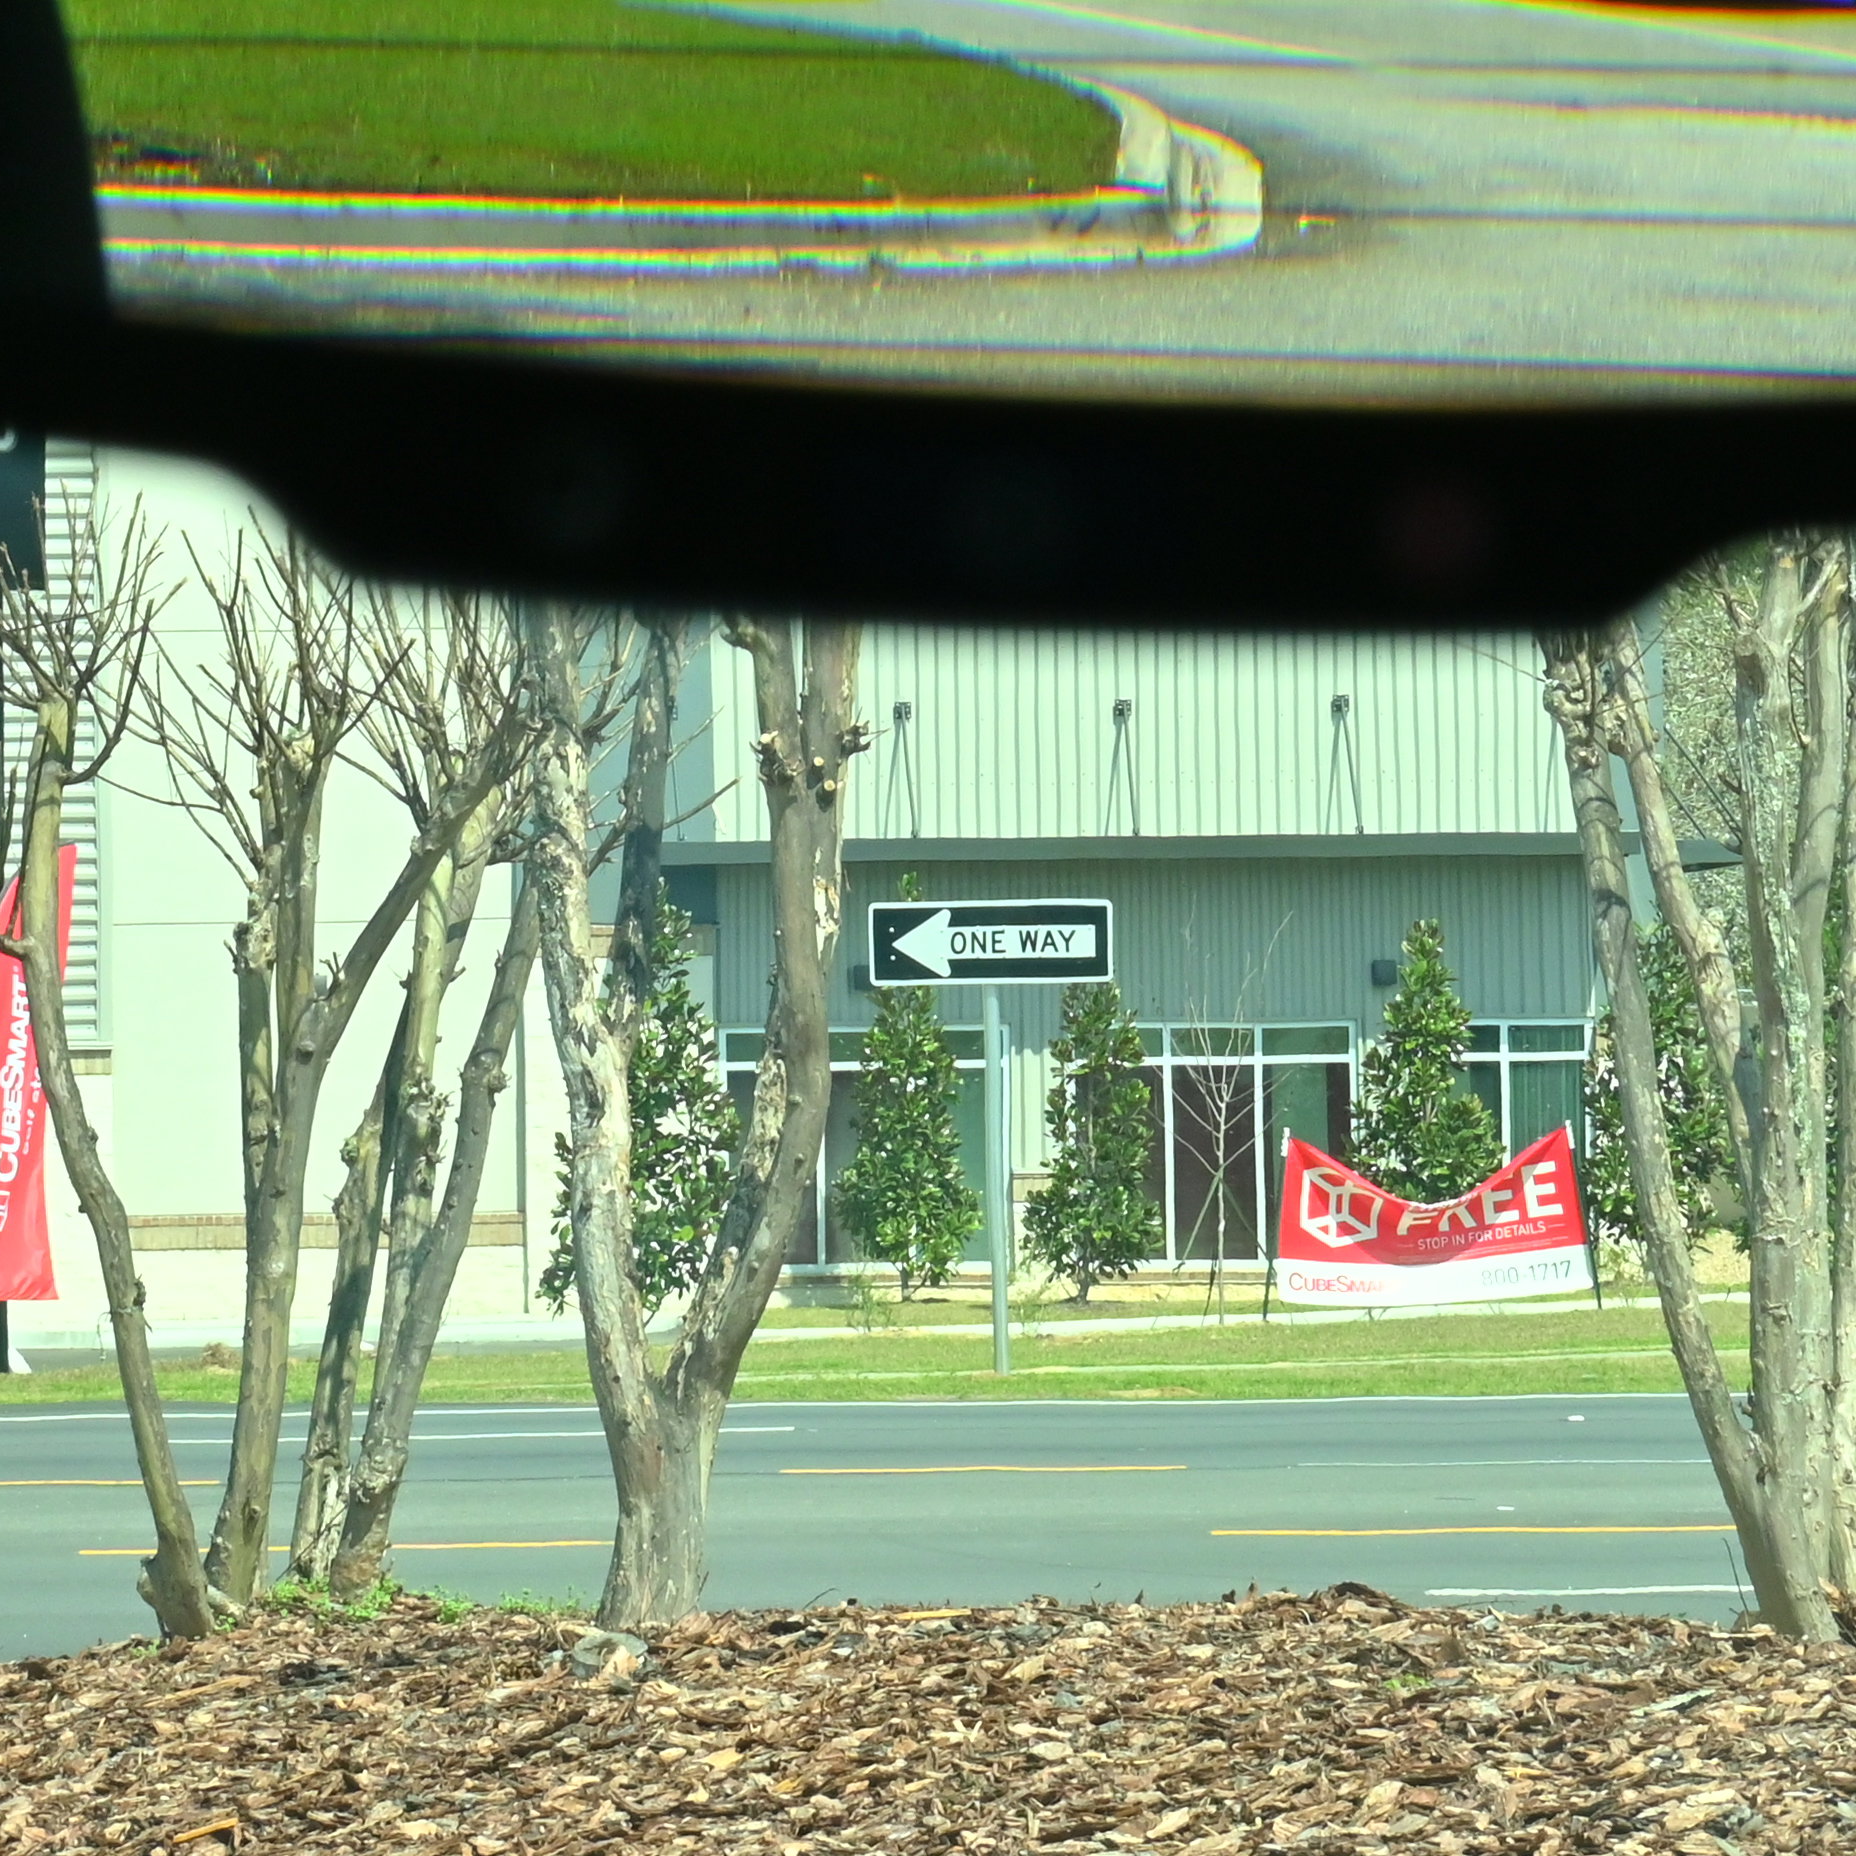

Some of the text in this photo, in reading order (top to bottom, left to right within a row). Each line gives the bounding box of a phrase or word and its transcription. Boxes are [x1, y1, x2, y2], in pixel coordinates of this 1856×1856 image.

[950, 929, 1077, 955] ONE WAY
[1417, 1221, 1547, 1251] STOP IN FOR DETAILS
